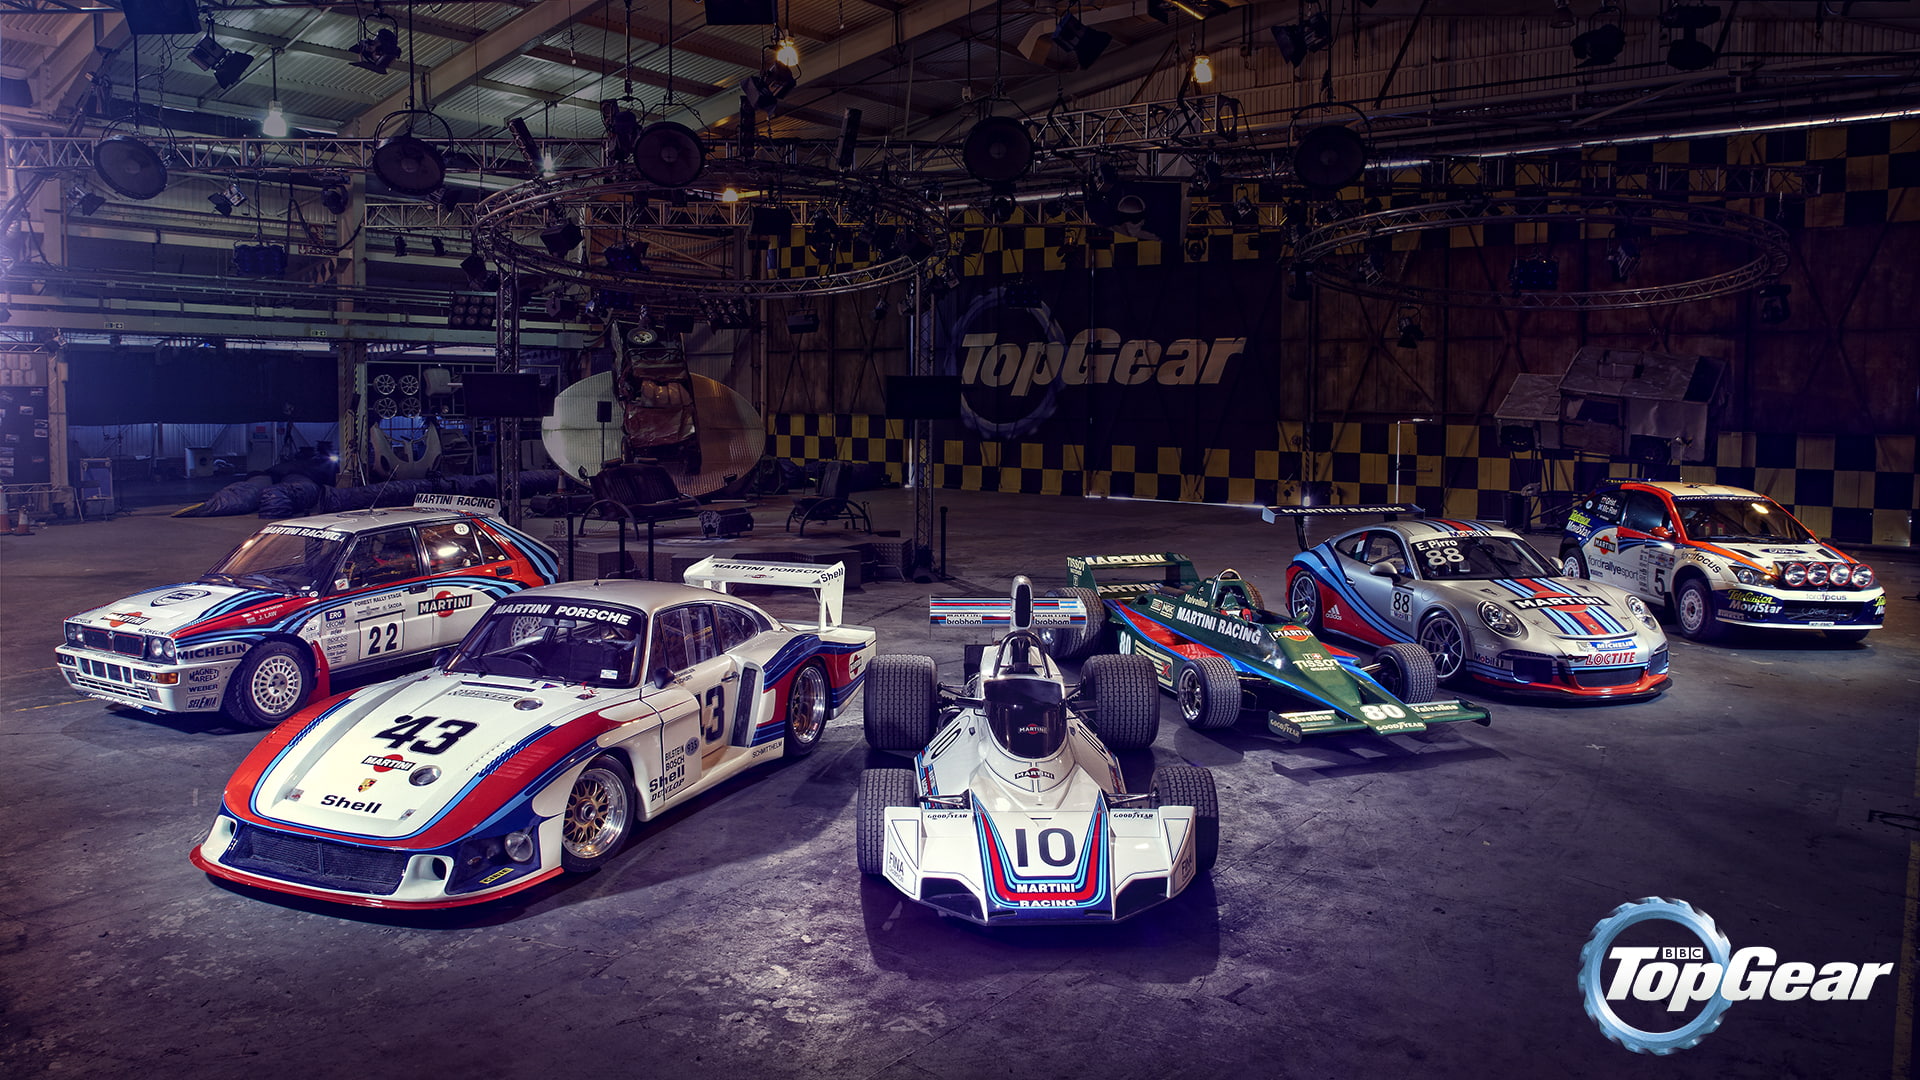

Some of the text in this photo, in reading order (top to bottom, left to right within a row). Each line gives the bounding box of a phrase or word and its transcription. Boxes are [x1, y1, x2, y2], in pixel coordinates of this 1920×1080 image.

[415, 494, 496, 508] MARTINI RACING
[260, 526, 341, 541] MARTINI RACING
[1595, 540, 1615, 552] MARTINI
[1067, 557, 1086, 571] TISSOT
[1426, 548, 1464, 566] 88
[821, 567, 844, 583] Shell
[1654, 568, 1666, 596] 5
[1097, 582, 1165, 593] ARTINI
[354, 599, 372, 607] FOREST
[420, 596, 470, 613] MARTINI
[1184, 594, 1209, 608] Valvoline
[1394, 592, 1410, 612] 88
[1514, 597, 1606, 609] MARTINI
[1729, 600, 1783, 614] MoviStar
[104, 613, 149, 625] MARTINI
[492, 604, 632, 626] MARTINI PORSCHE
[138, 627, 165, 635] MICHELIN
[1176, 606, 1262, 645] MARTINI RACING
[368, 623, 398, 655] 22
[1273, 630, 1314, 638] MARTIN
[1118, 631, 1132, 655] 80
[1596, 640, 1634, 649] MICHELIN
[177, 645, 247, 661] MICHELIN
[1474, 652, 1495, 666] Mobil
[1585, 652, 1636, 665] LOCTITE
[1292, 659, 1340, 670] TISSOT
[188, 684, 218, 692] WEBER
[1360, 704, 1406, 720] 80
[1411, 704, 1458, 713] Valvoline
[1287, 714, 1332, 724] alvoline
[372, 716, 479, 755] 43
[665, 744, 684, 761] BILSTEIN
[686, 740, 698, 753] 935
[364, 756, 413, 770] MARTINI
[665, 756, 685, 772] BOSCH
[648, 765, 686, 792] Shell
[1017, 770, 1054, 778] MARTINI
[650, 778, 686, 802] DUNLOP
[321, 794, 382, 814] Shell
[1015, 828, 1076, 867] 10
[889, 852, 904, 876] FINA
[1016, 884, 1075, 893] MARTINI
